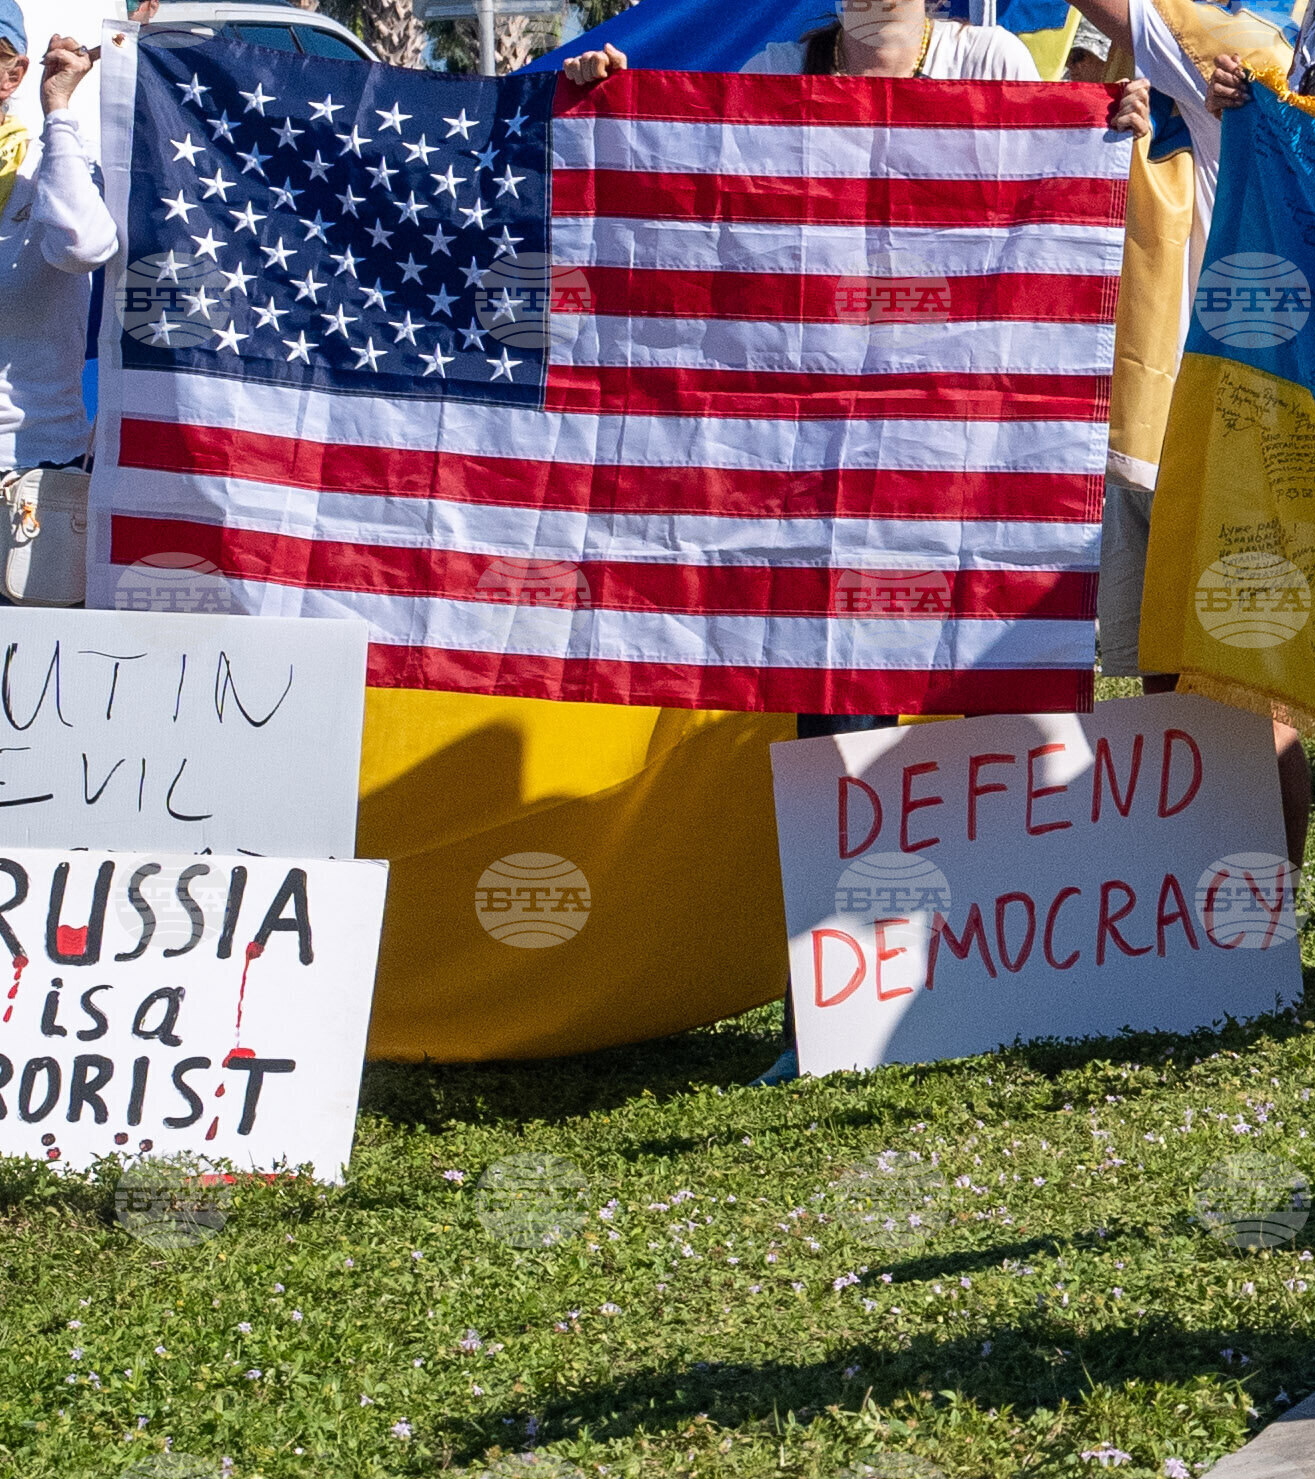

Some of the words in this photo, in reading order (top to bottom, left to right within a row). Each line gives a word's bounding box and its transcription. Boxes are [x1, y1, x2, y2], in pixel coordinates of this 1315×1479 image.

[836, 728, 1203, 860] DEFEND
[0, 858, 314, 967] RUSSIA
[811, 864, 1288, 1009] DEMOCRACY
[131, 986, 186, 1047] a
